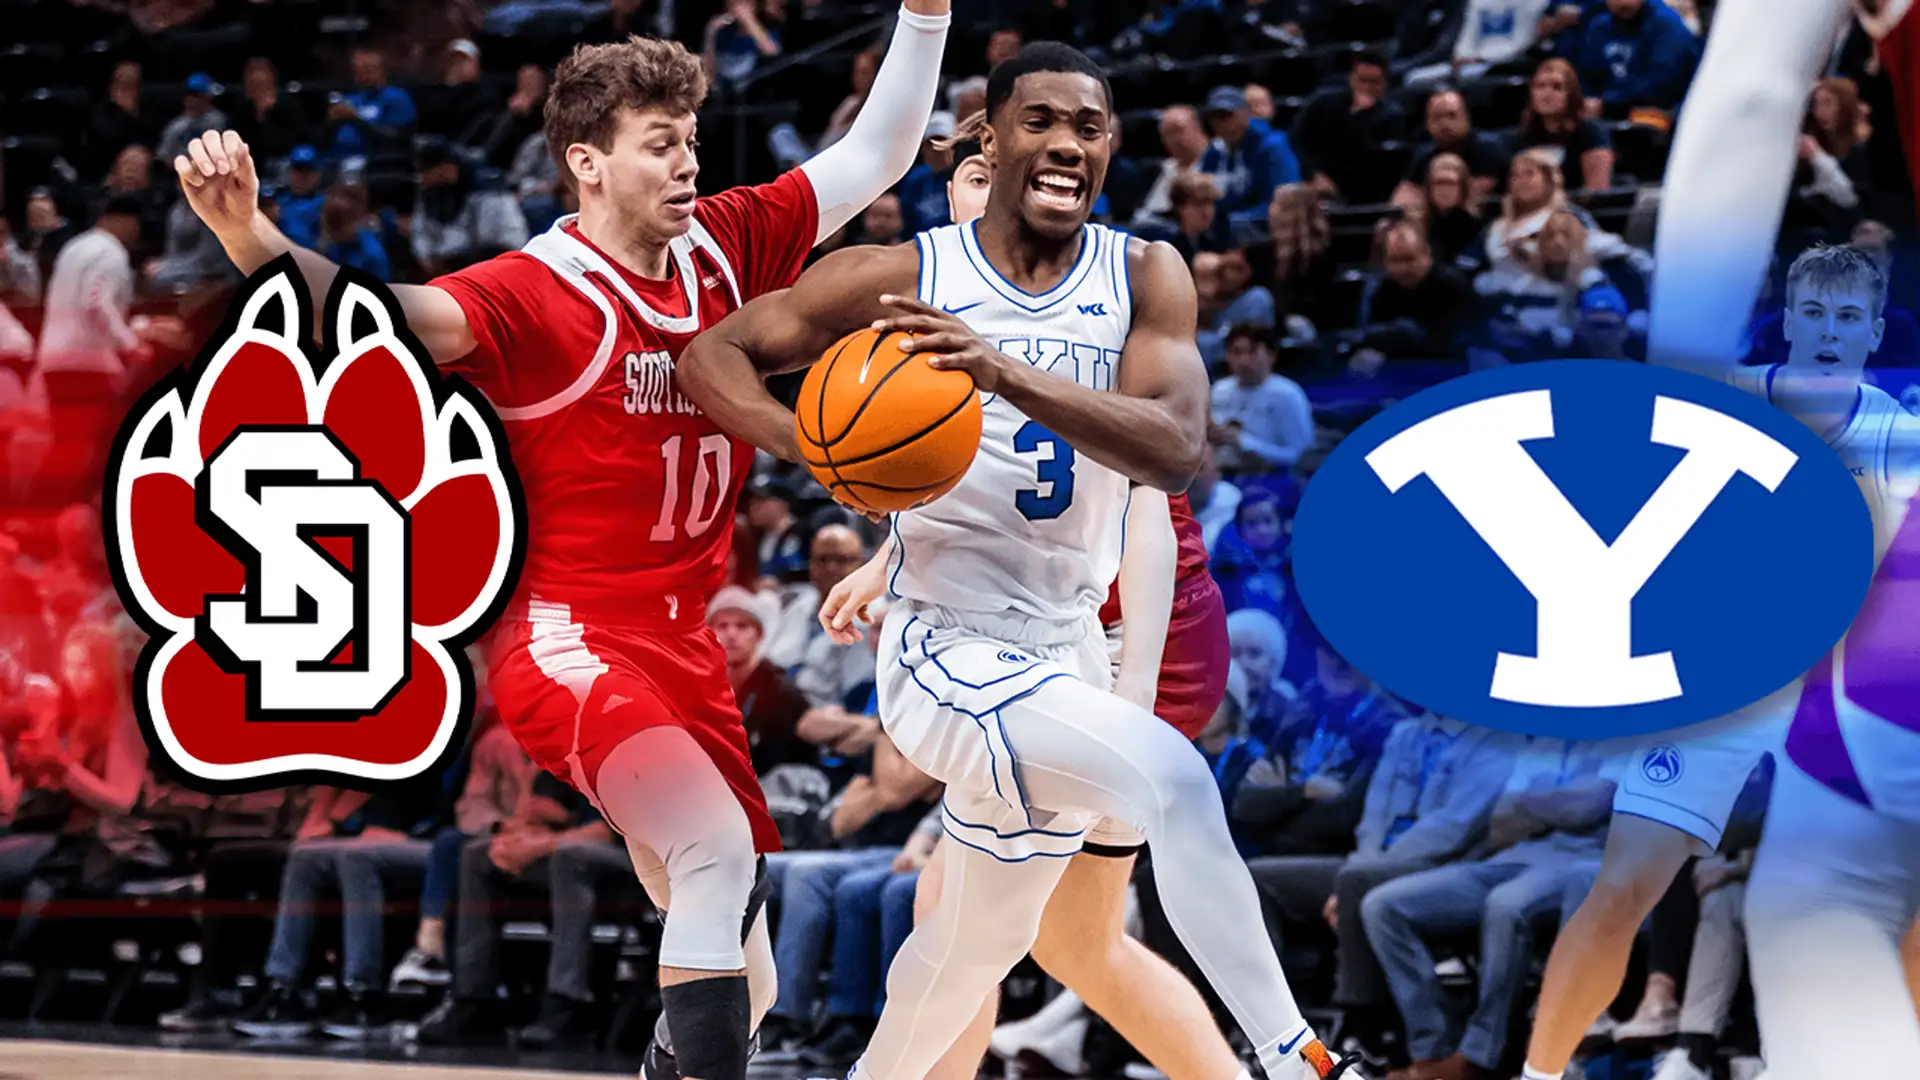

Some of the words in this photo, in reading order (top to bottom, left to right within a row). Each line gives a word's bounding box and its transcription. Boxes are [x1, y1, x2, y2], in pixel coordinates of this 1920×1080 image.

[1077, 303, 1107, 316] WCC
[623, 350, 691, 415] SOUT
[649, 433, 731, 542] 10
[1013, 420, 1076, 521] 3
